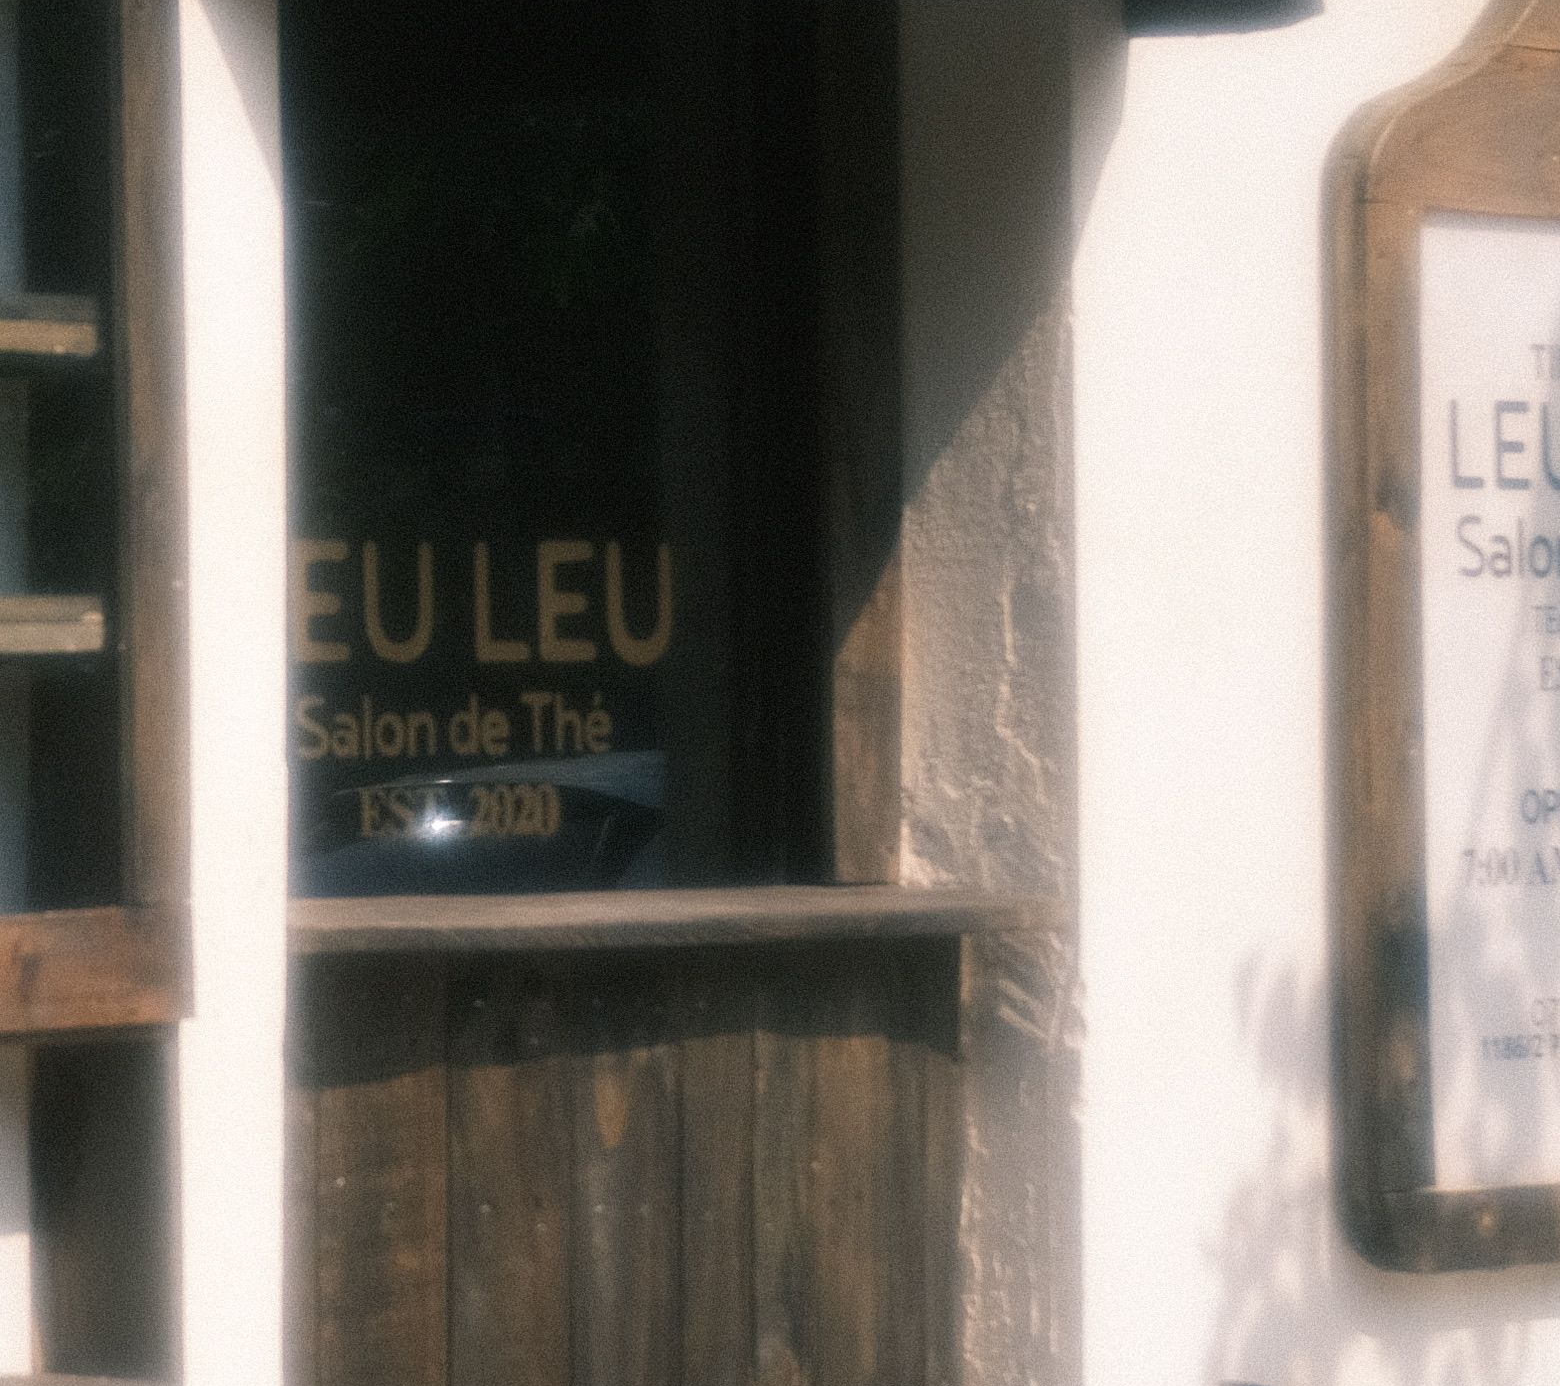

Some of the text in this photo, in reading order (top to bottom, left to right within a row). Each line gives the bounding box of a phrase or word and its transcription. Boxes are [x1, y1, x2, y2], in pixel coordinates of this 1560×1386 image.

[288, 539, 674, 666] EU LEU
[295, 692, 614, 761] Salon de Thé
[469, 784, 562, 838] 2020
